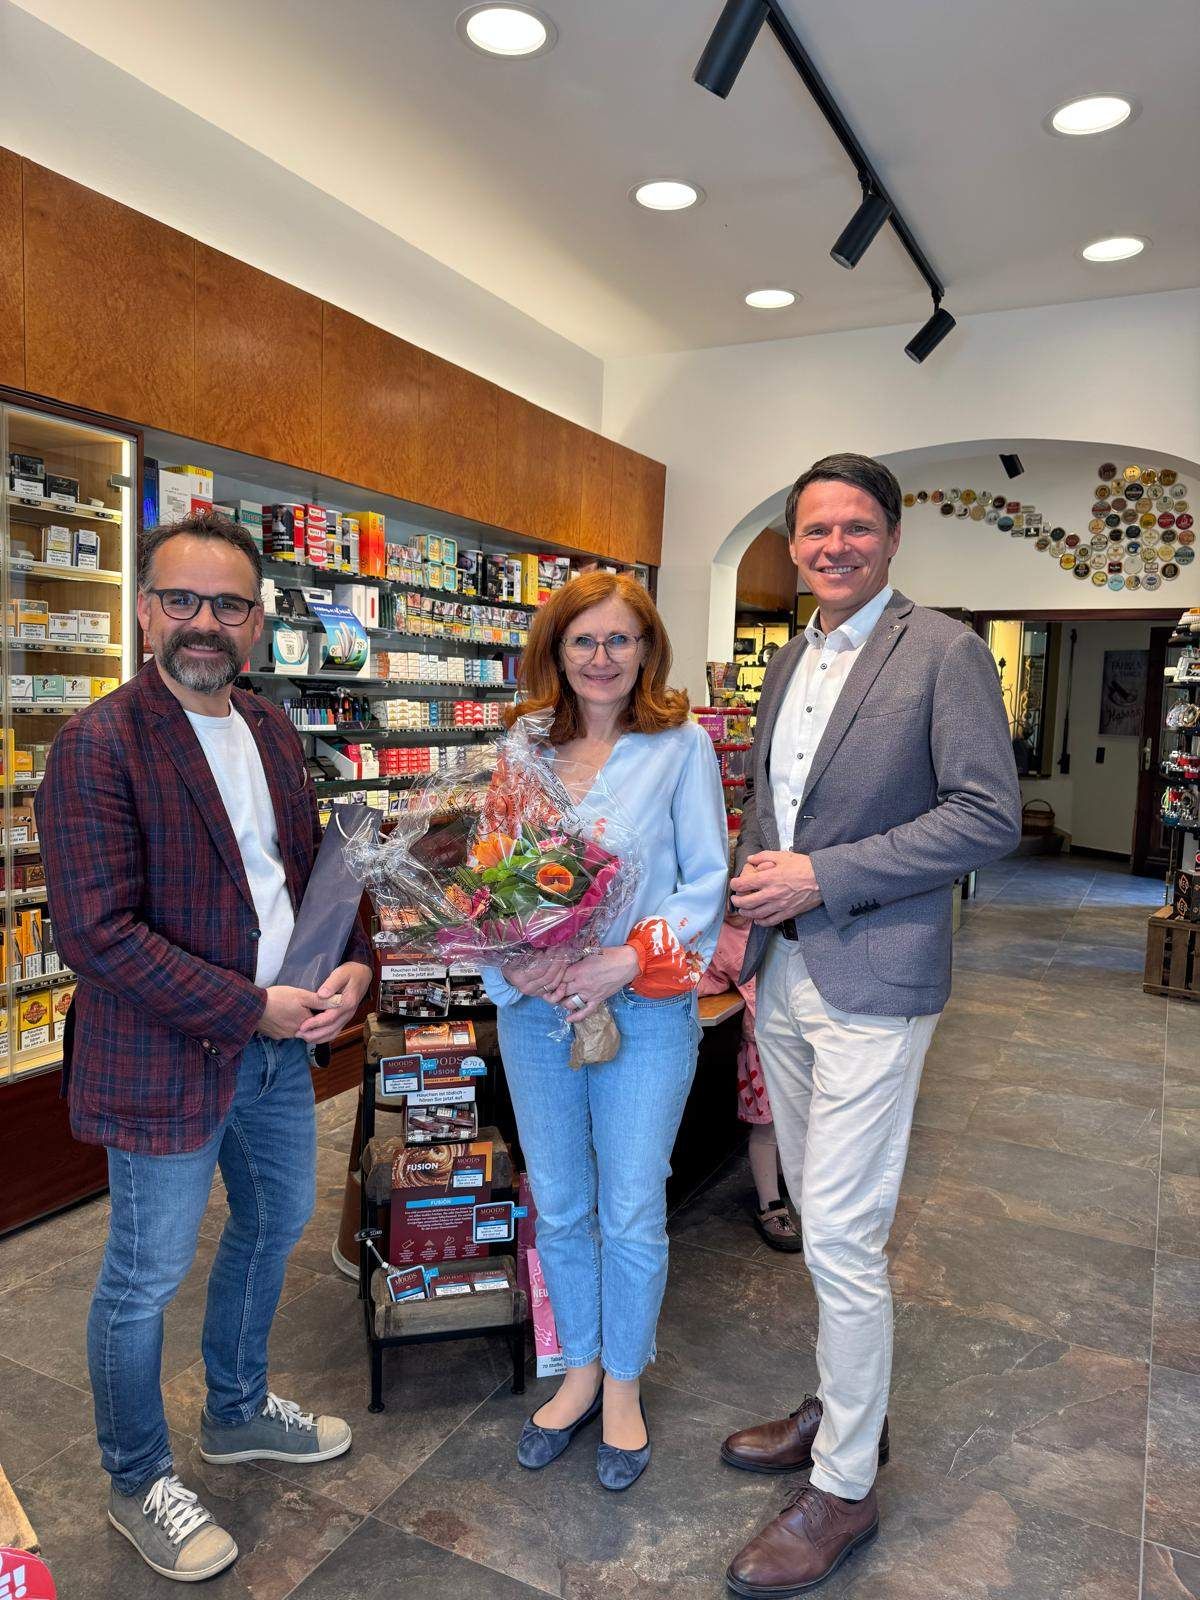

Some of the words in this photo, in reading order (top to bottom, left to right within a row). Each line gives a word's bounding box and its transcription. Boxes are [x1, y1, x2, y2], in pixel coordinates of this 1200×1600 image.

[406, 1162, 439, 1171] FUSION
[480, 1207, 505, 1215] MOODS
[395, 1273, 418, 1285] MOODS
